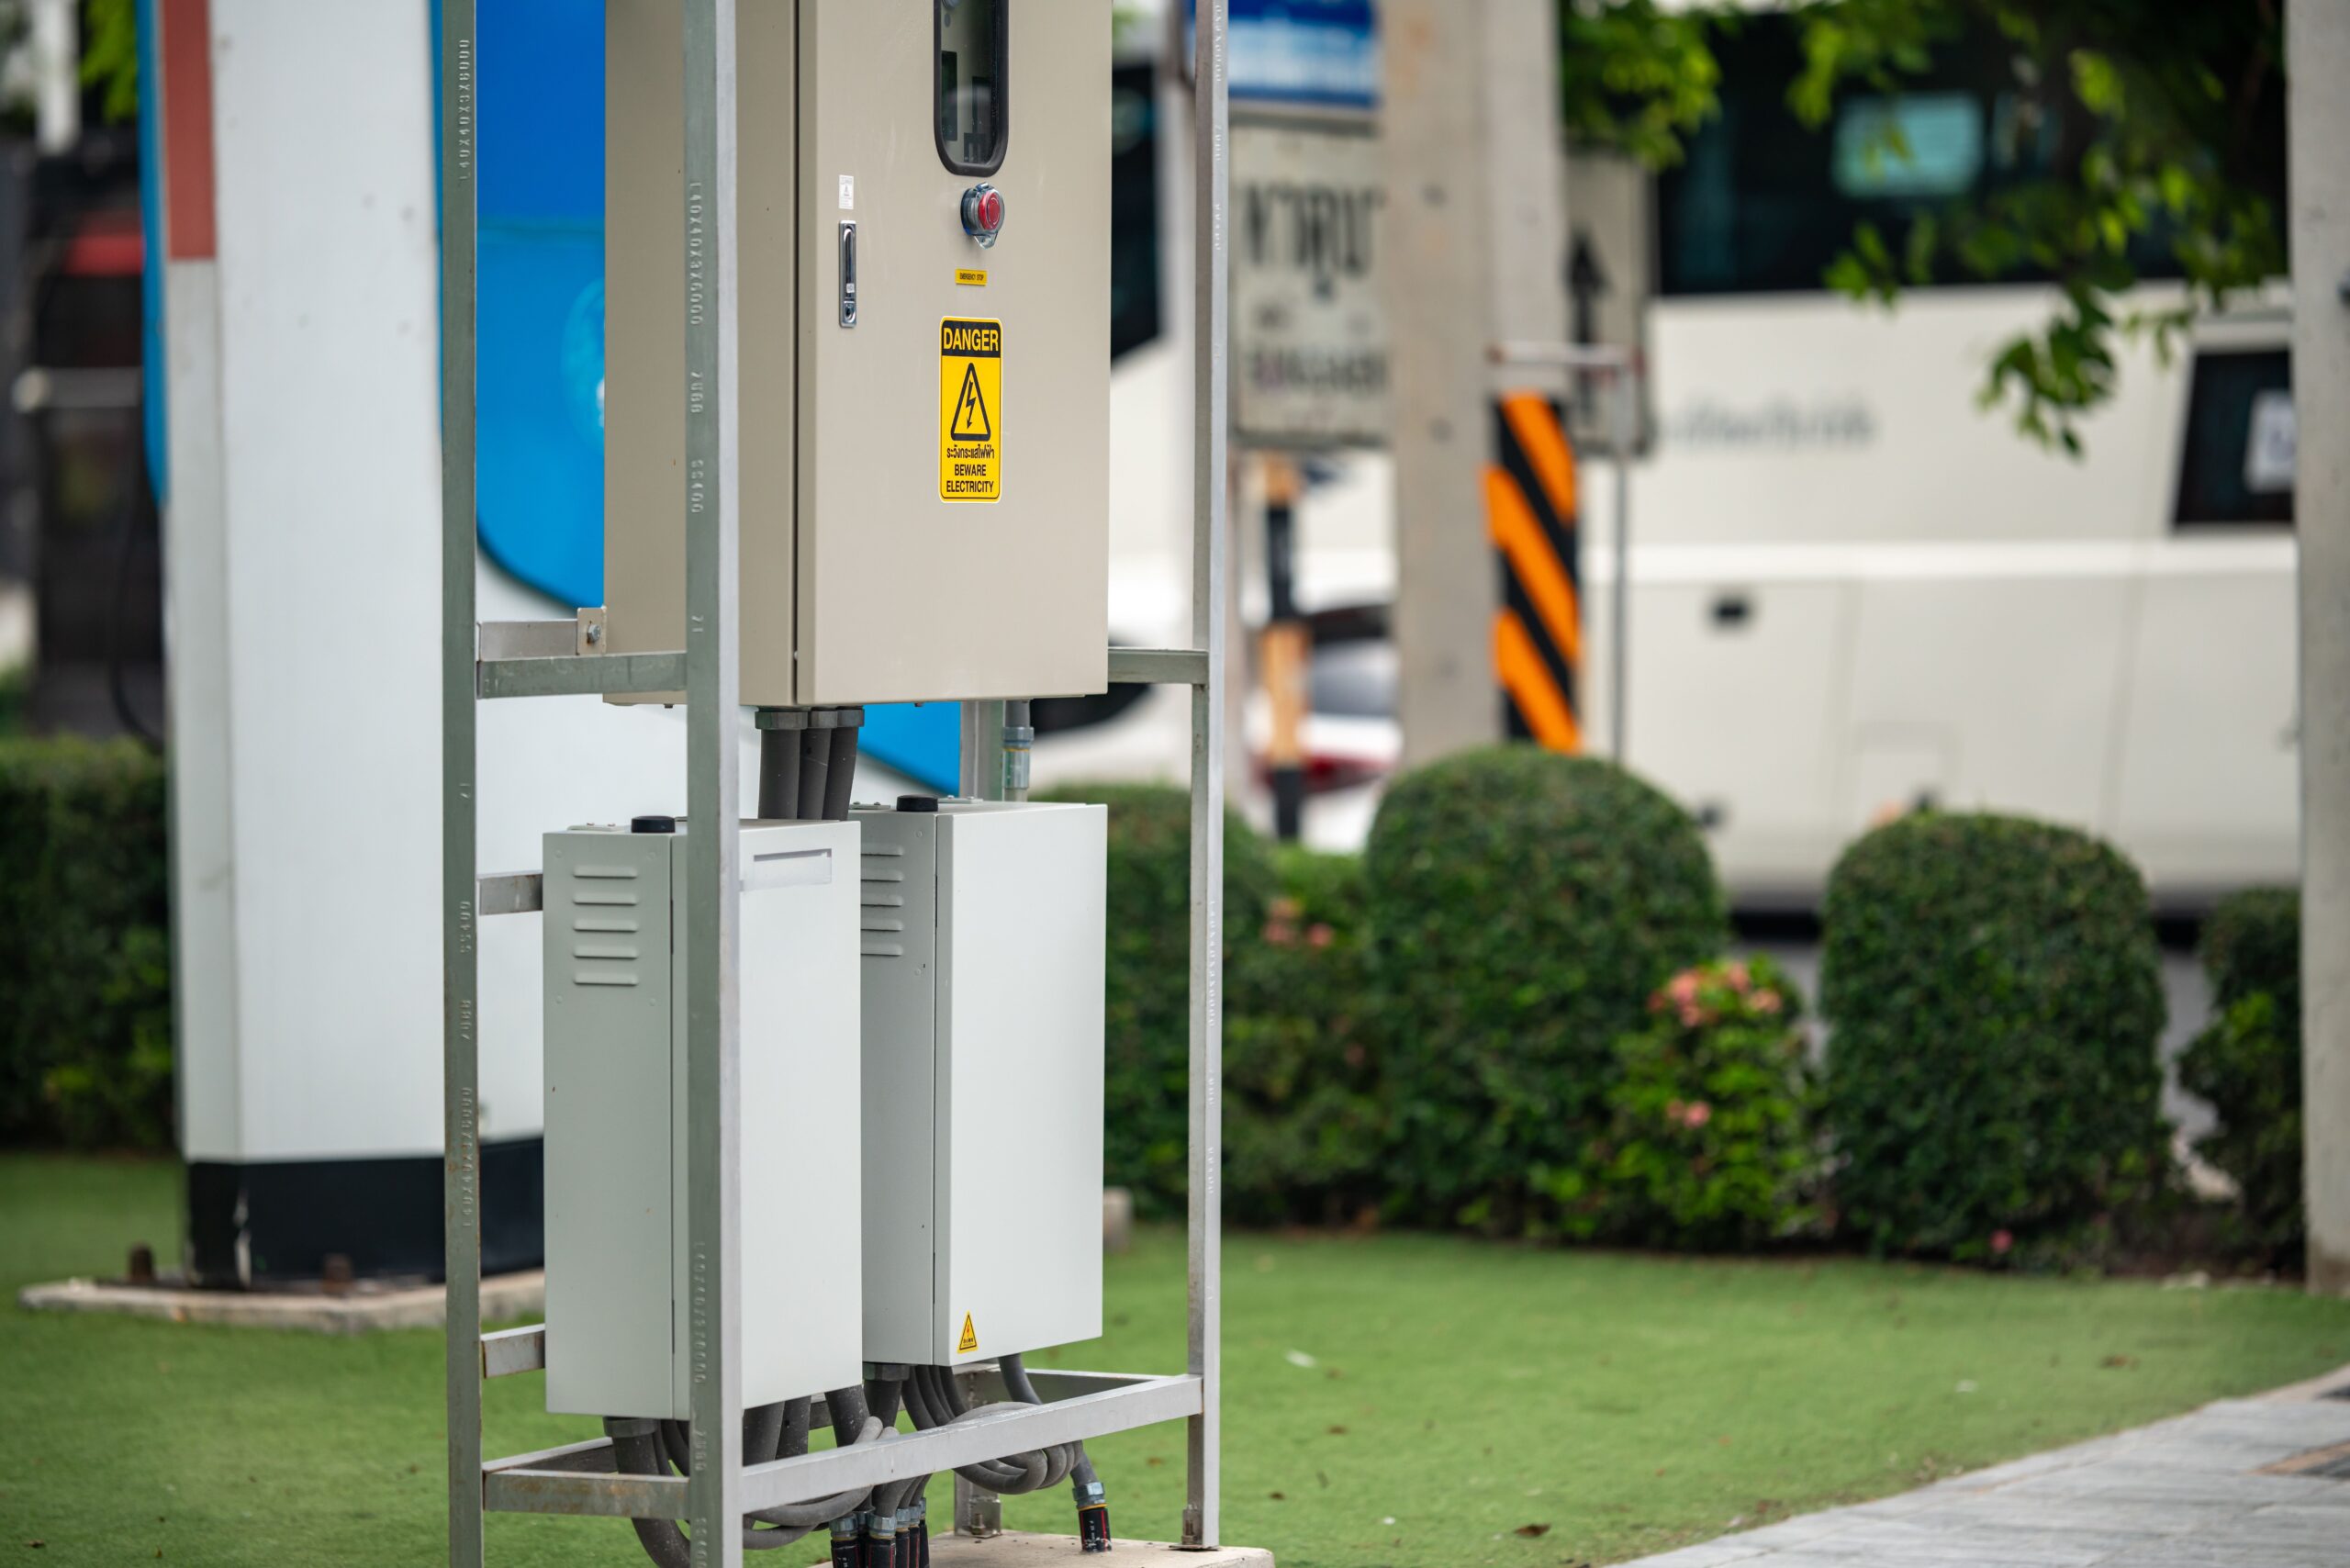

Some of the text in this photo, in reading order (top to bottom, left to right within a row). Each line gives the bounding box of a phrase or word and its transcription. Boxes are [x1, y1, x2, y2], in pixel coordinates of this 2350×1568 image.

[943, 327, 999, 352] DANGER
[946, 443, 995, 459] ระวังกระแสไฟฟ้า
[954, 464, 987, 476] BEWARE
[946, 480, 994, 493] ELECTRICITY
